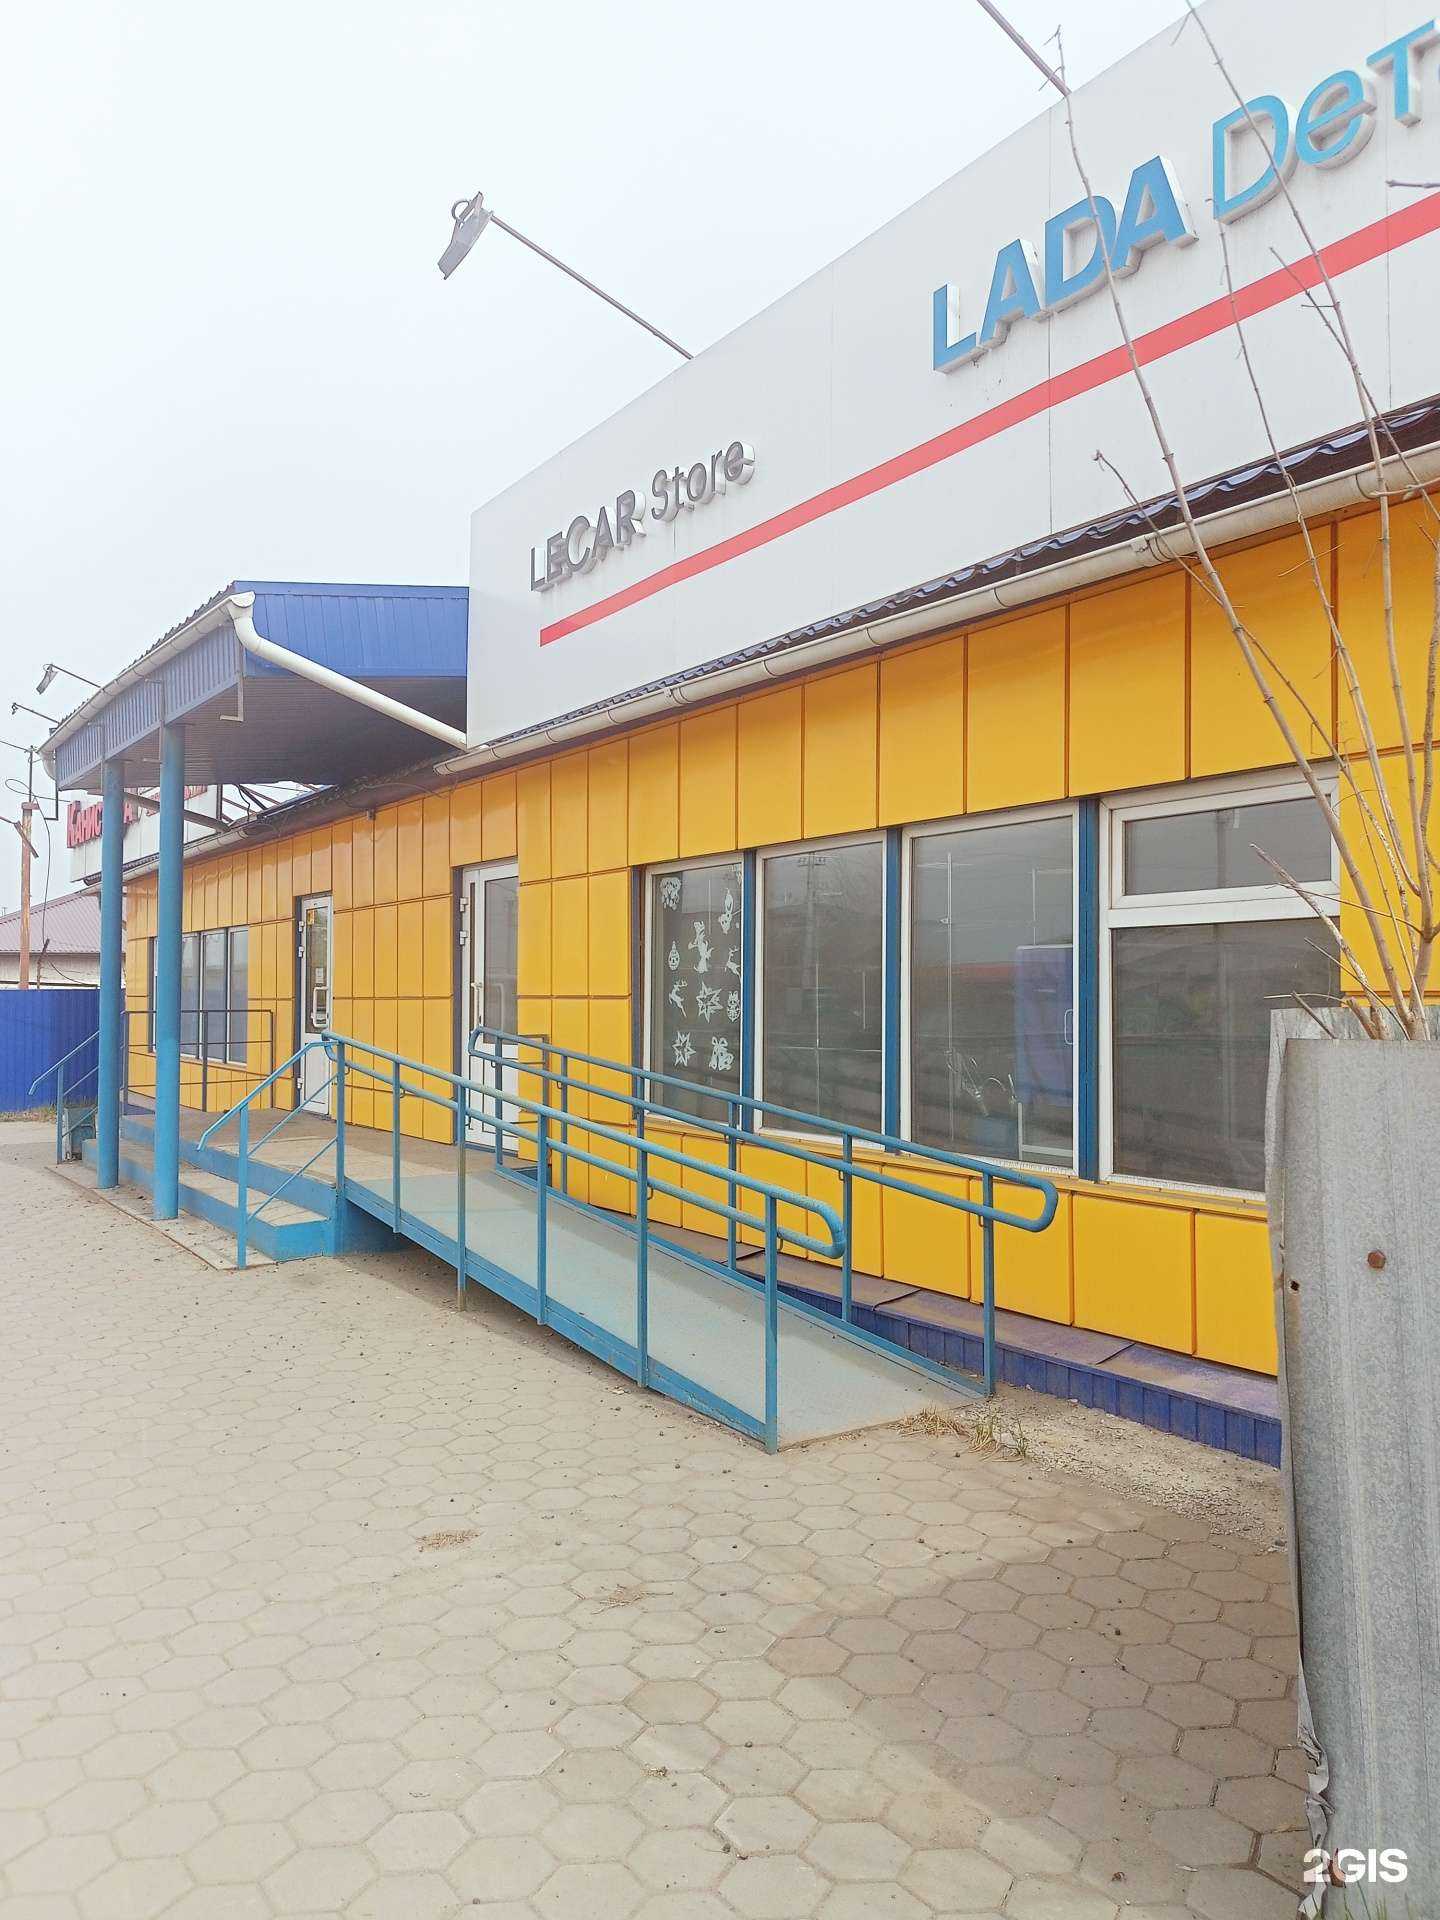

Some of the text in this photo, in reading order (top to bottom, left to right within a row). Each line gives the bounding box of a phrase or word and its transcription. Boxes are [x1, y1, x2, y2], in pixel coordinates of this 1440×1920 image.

[933, 155, 1199, 374] LADA
[530, 440, 755, 593] LECAR Store
